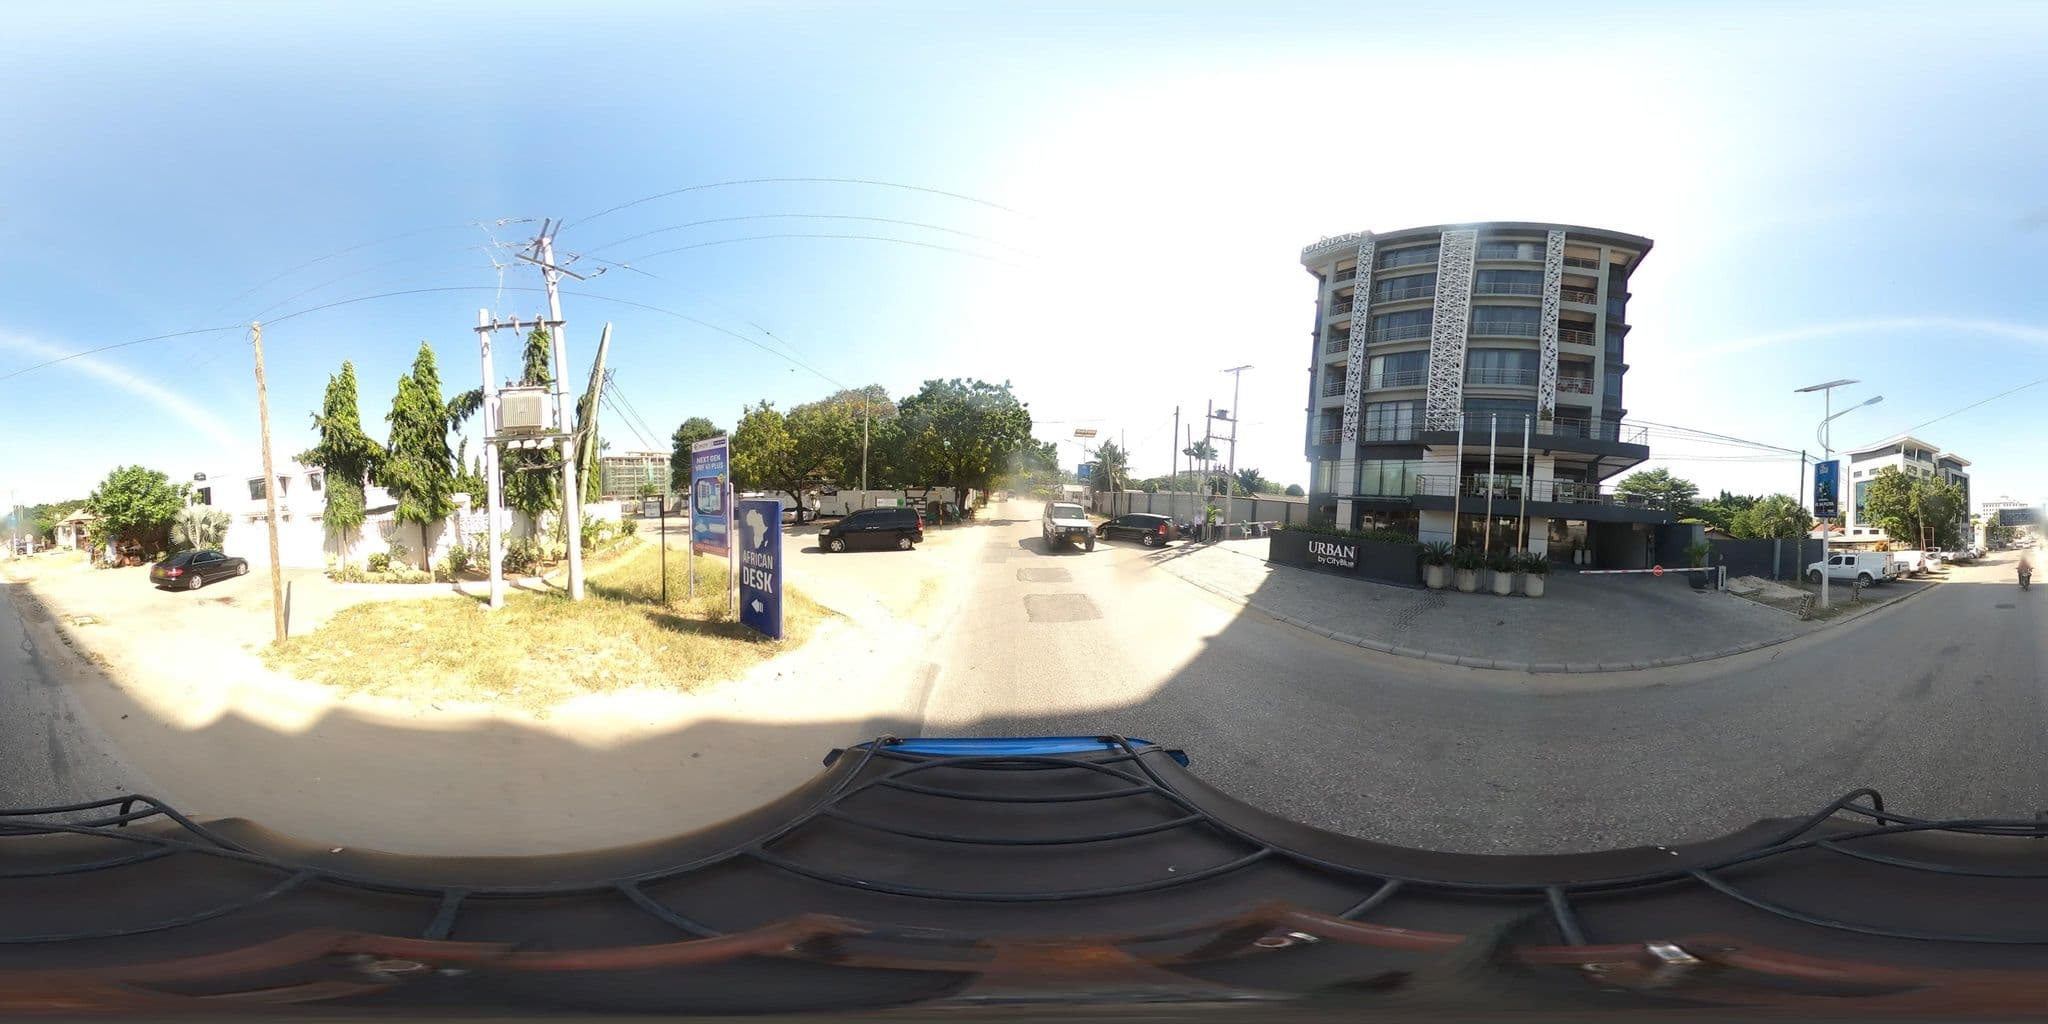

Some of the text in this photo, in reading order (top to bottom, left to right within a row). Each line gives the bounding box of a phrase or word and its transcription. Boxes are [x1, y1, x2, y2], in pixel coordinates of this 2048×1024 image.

[710, 454, 721, 463] GEN
[1308, 540, 1355, 559] URBAN
[743, 549, 773, 570] AFRICAN
[1317, 555, 1354, 568] by CityBlue
[743, 565, 773, 594] DESK
